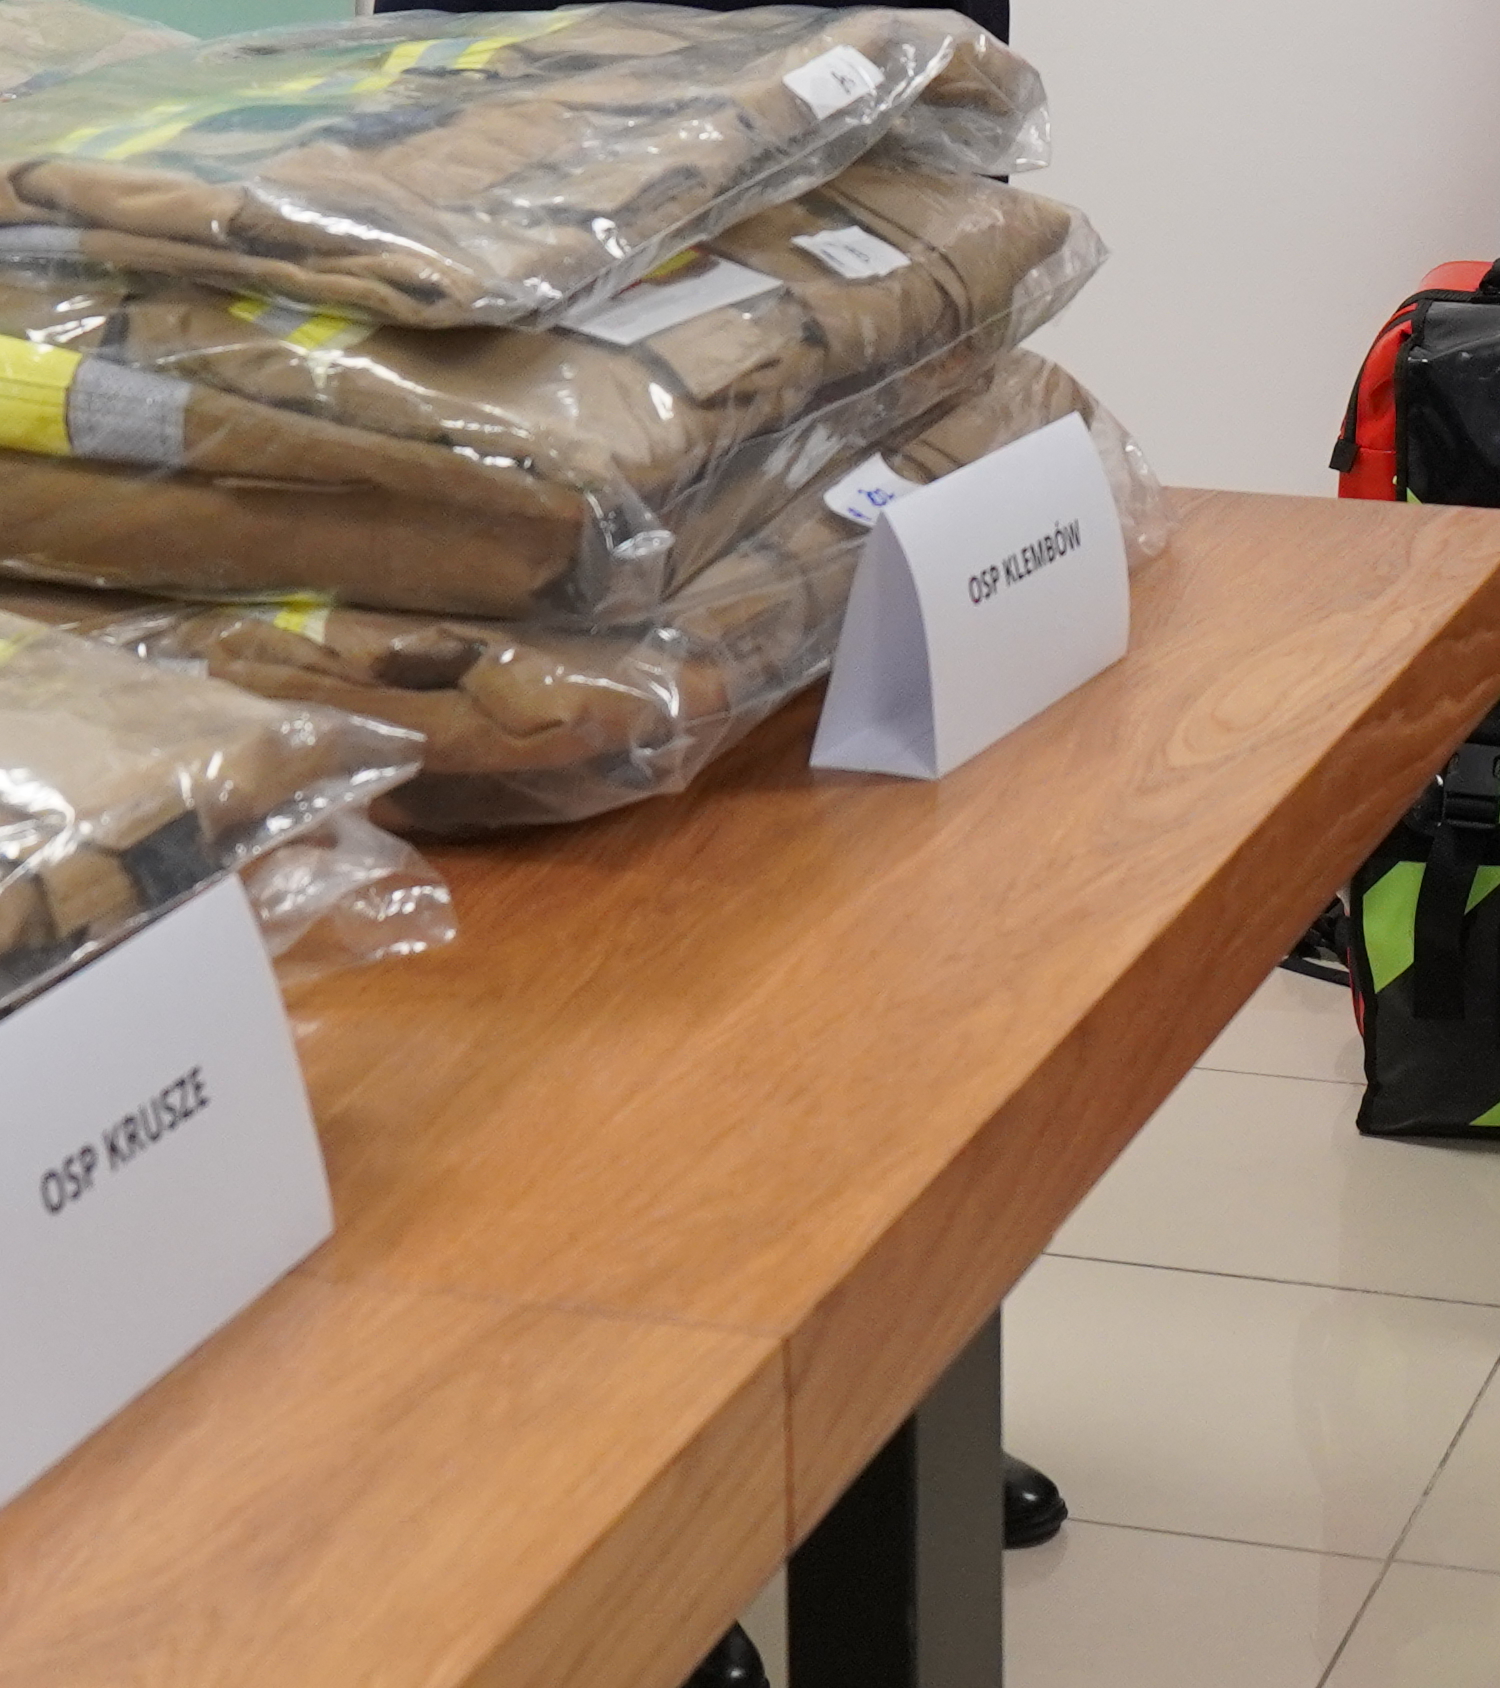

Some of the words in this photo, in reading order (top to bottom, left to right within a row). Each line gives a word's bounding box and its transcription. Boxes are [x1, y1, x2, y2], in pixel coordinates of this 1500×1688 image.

[968, 564, 999, 604] OSP
[1001, 518, 1081, 587] KLEMBÓW
[39, 1144, 97, 1214] OSP
[102, 1065, 210, 1174] KRUSZE
